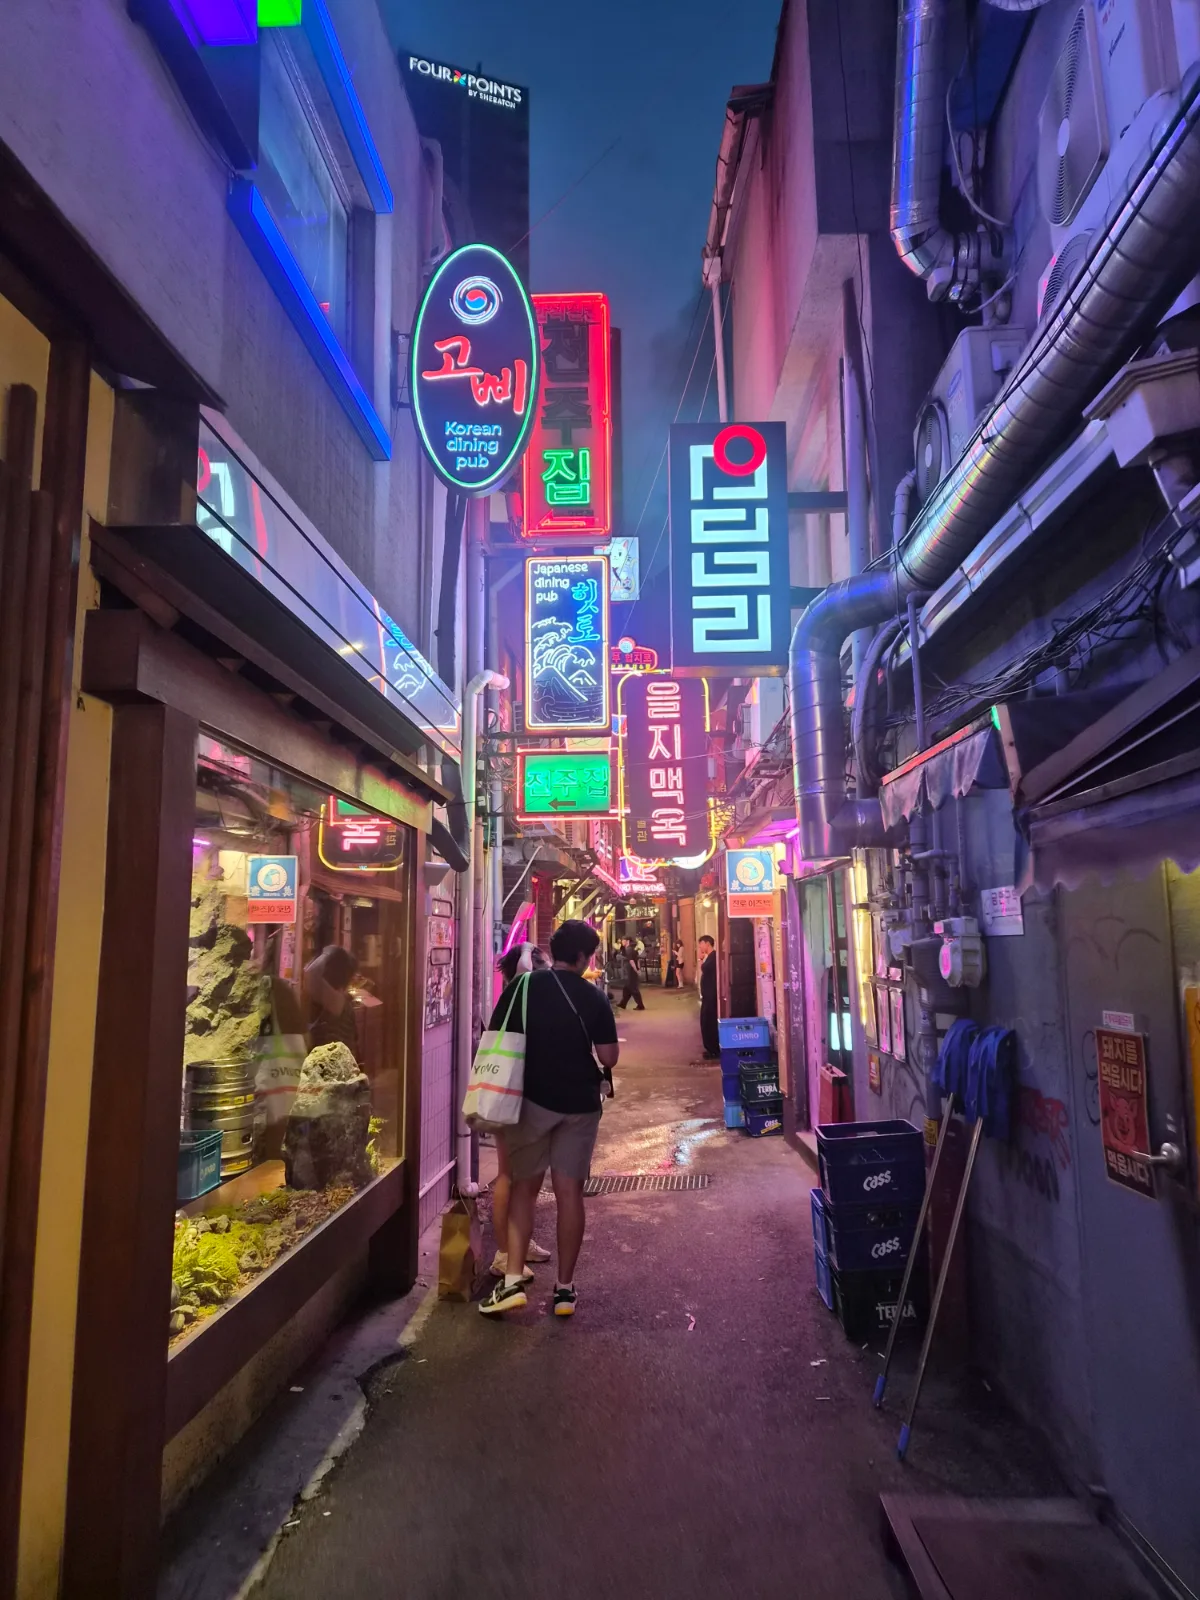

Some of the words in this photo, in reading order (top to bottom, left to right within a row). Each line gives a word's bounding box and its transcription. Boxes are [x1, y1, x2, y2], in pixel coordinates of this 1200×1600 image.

[409, 56, 453, 82] FOUR
[467, 74, 522, 102] POINTS
[468, 89, 478, 97] BY
[479, 92, 516, 109] SHERATON
[444, 421, 502, 436] Korean
[446, 437, 499, 454] dining
[455, 454, 489, 471] pub
[534, 563, 588, 576] Japanese
[534, 577, 570, 590] dining
[536, 591, 559, 604] pub
[646, 681, 687, 846] 을지맥옥
[739, 1032, 759, 1041] JINRO
[1102, 1035, 1138, 1065] 돼지를
[757, 1084, 777, 1094] TERRA
[764, 1119, 779, 1128] Cass
[863, 1170, 891, 1191] Cass
[871, 1236, 900, 1259] Cass
